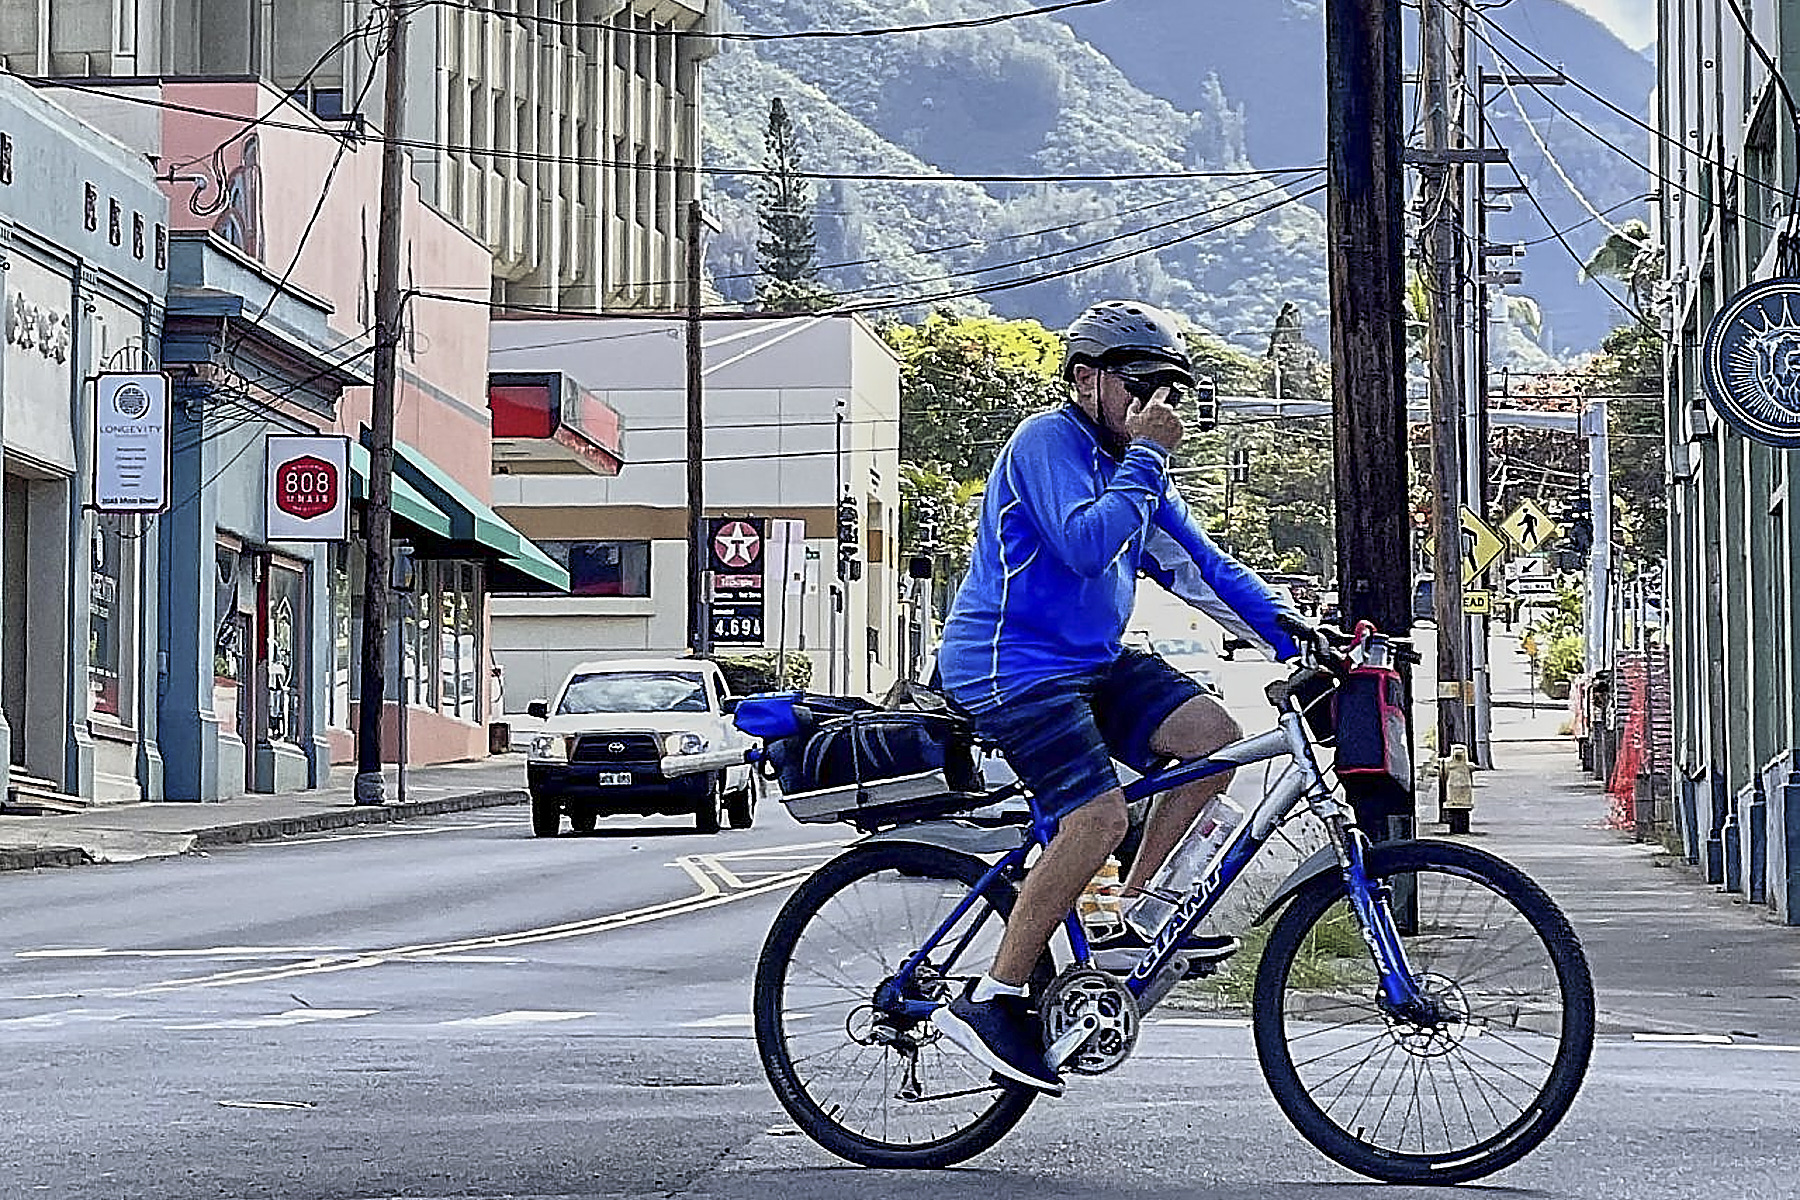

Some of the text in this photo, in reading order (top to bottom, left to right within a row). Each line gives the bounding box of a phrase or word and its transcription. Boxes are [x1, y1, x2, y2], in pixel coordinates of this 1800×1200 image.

[100, 425, 162, 434] LONGEVITY
[285, 472, 329, 493] 808
[1464, 596, 1486, 607] EAD
[1134, 861, 1224, 979] GIANT
